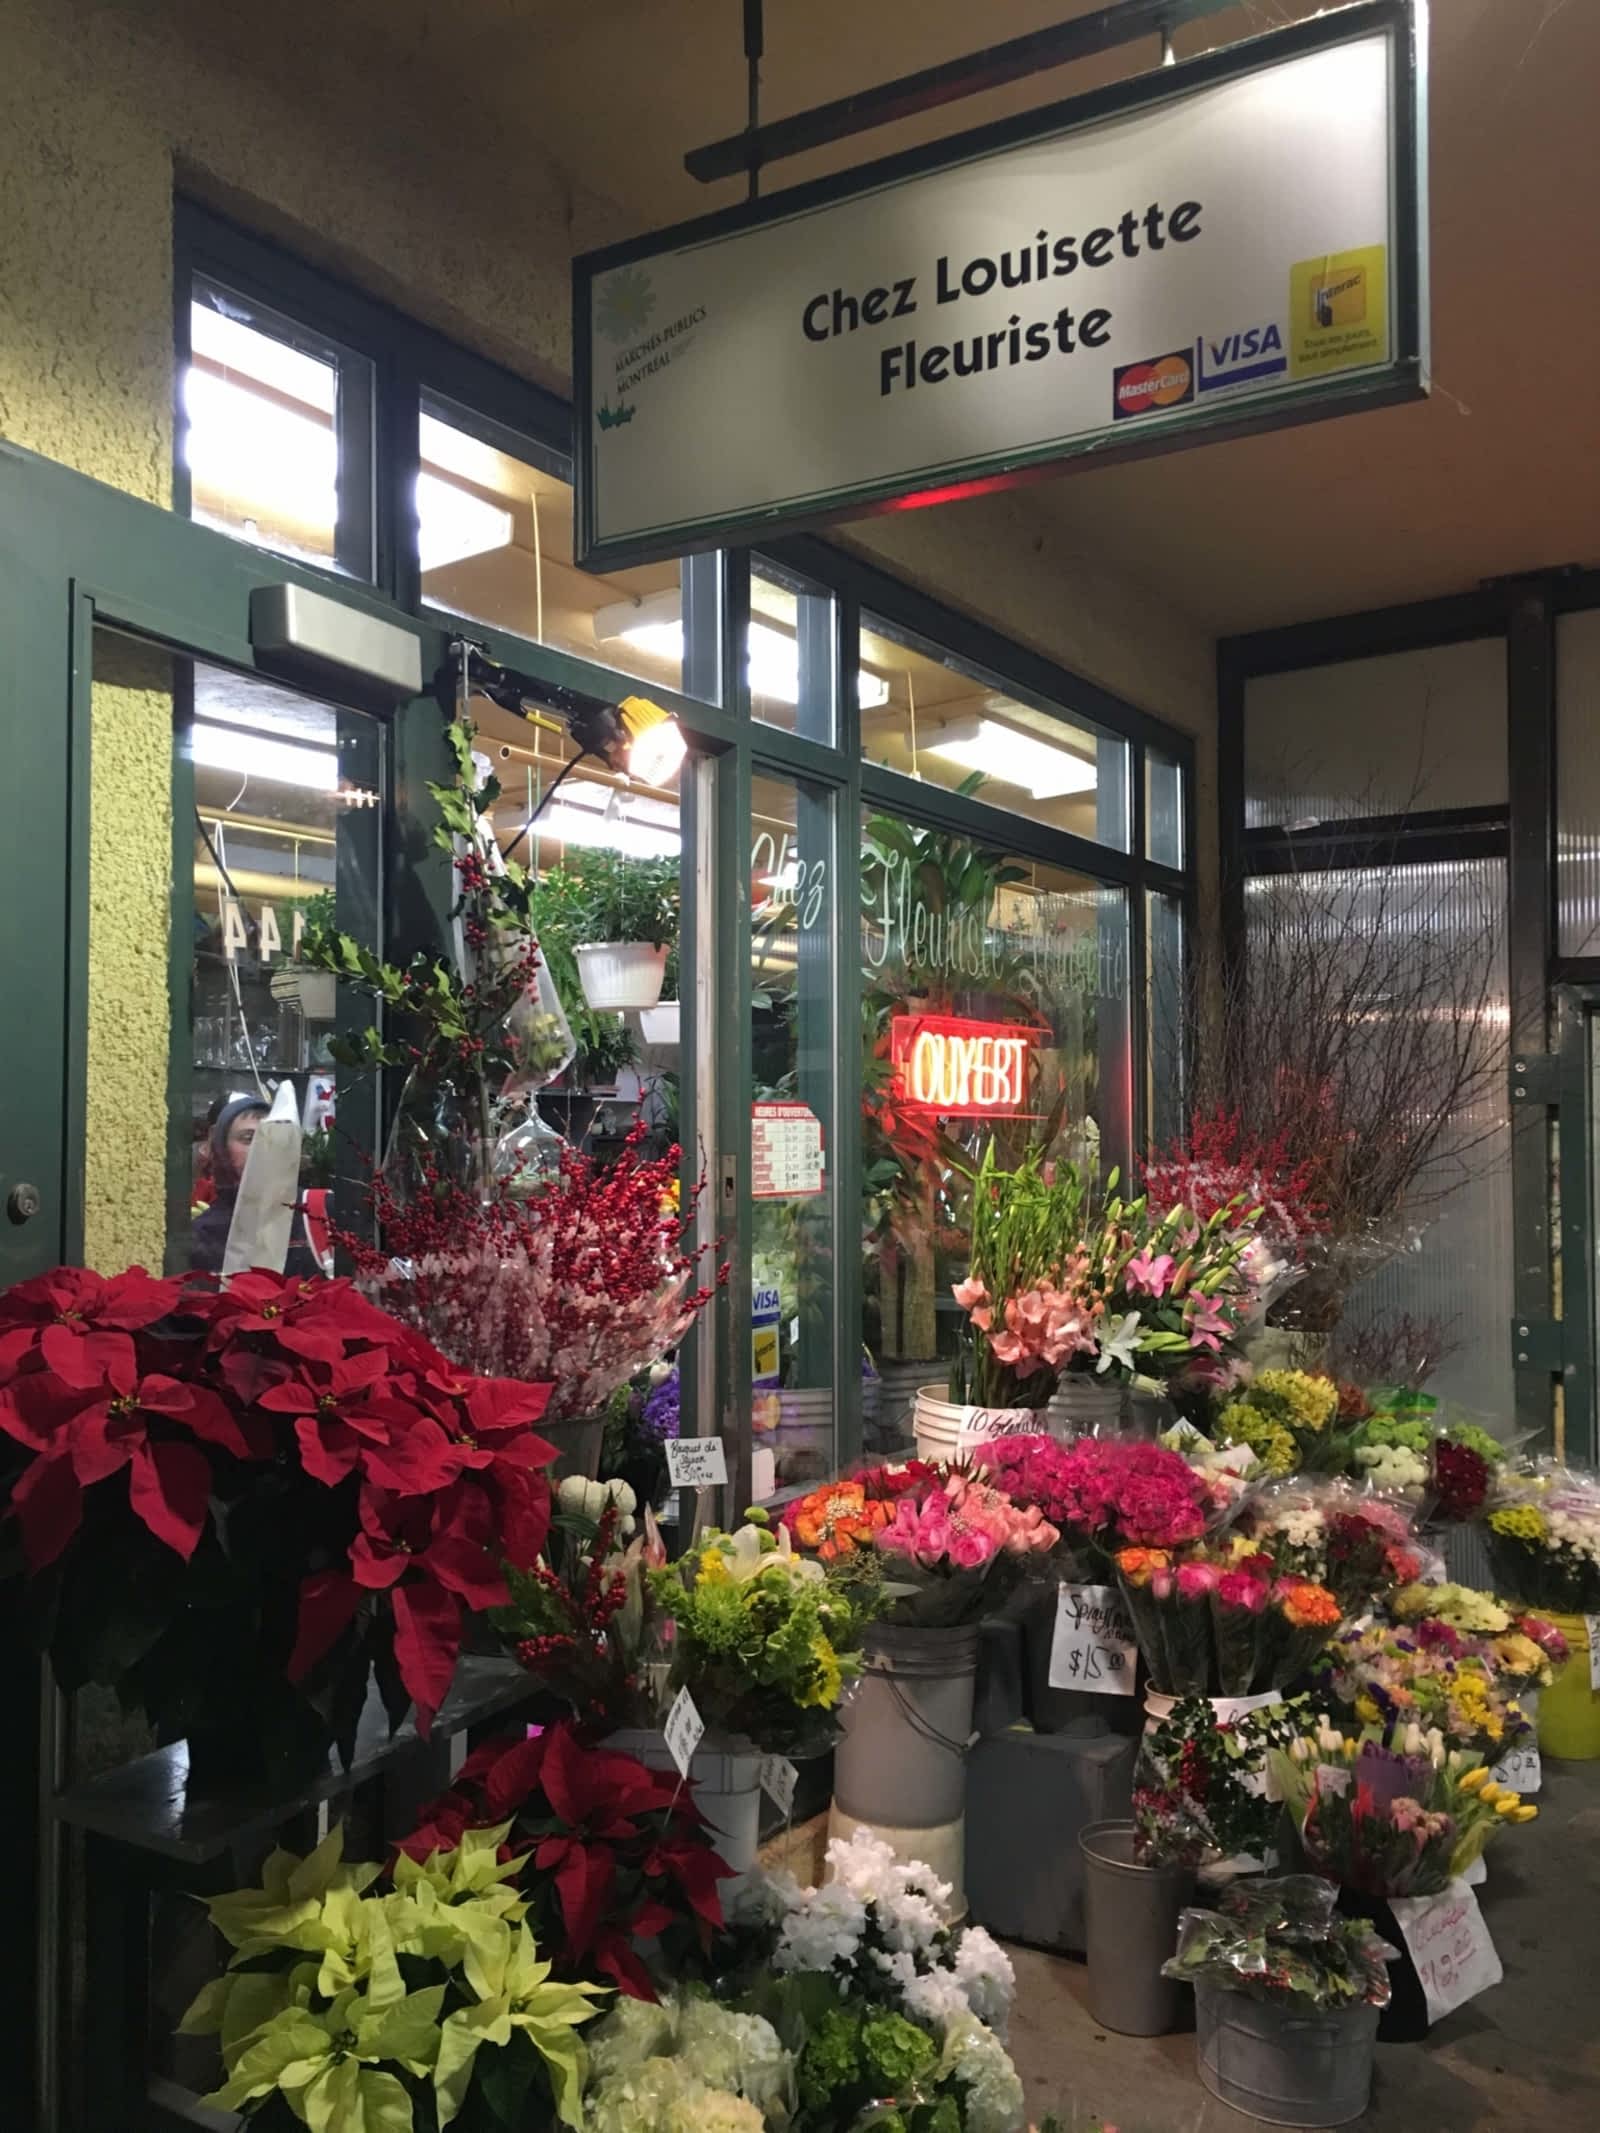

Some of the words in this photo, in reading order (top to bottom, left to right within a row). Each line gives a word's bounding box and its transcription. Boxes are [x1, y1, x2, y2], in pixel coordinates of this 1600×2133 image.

[802, 277, 918, 341] Chez
[936, 201, 1203, 304] Louisette
[880, 307, 1113, 396] Fleuriste
[1210, 324, 1282, 367] VISA
[1118, 373, 1190, 401] MasterCard
[914, 1030, 1027, 1106] OUVERT
[752, 1289, 780, 1311] VISA
